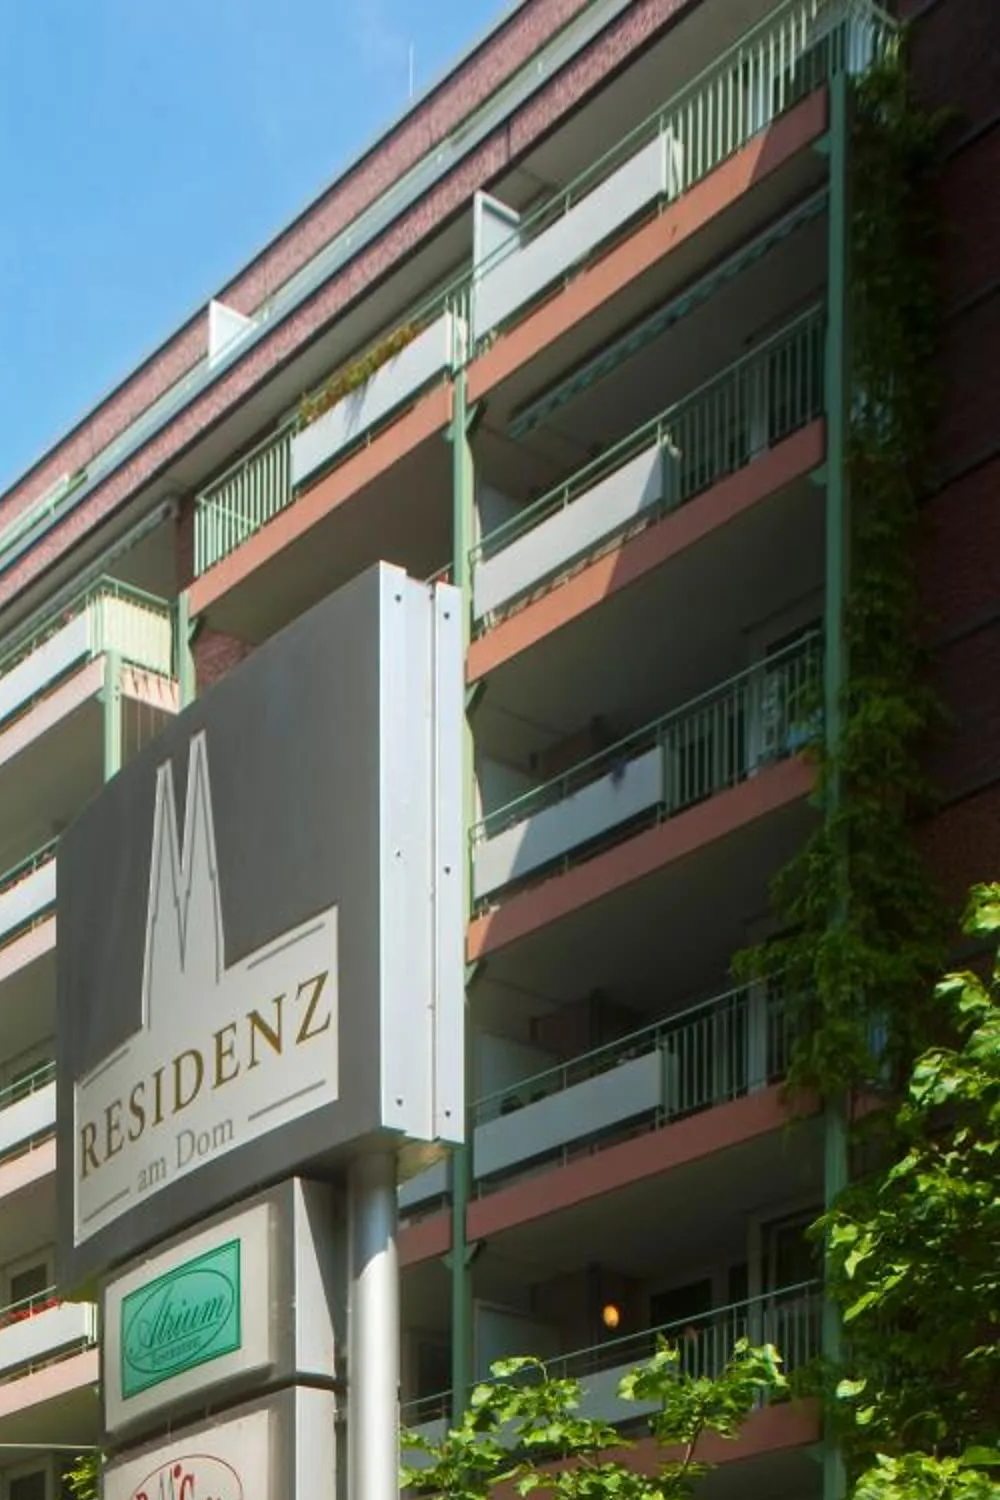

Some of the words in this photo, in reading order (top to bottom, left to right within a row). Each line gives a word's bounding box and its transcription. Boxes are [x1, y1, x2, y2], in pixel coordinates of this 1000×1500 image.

[80, 970, 331, 1180] RESIDENZ
[137, 1156, 167, 1193] am
[177, 1118, 235, 1169] Dom
